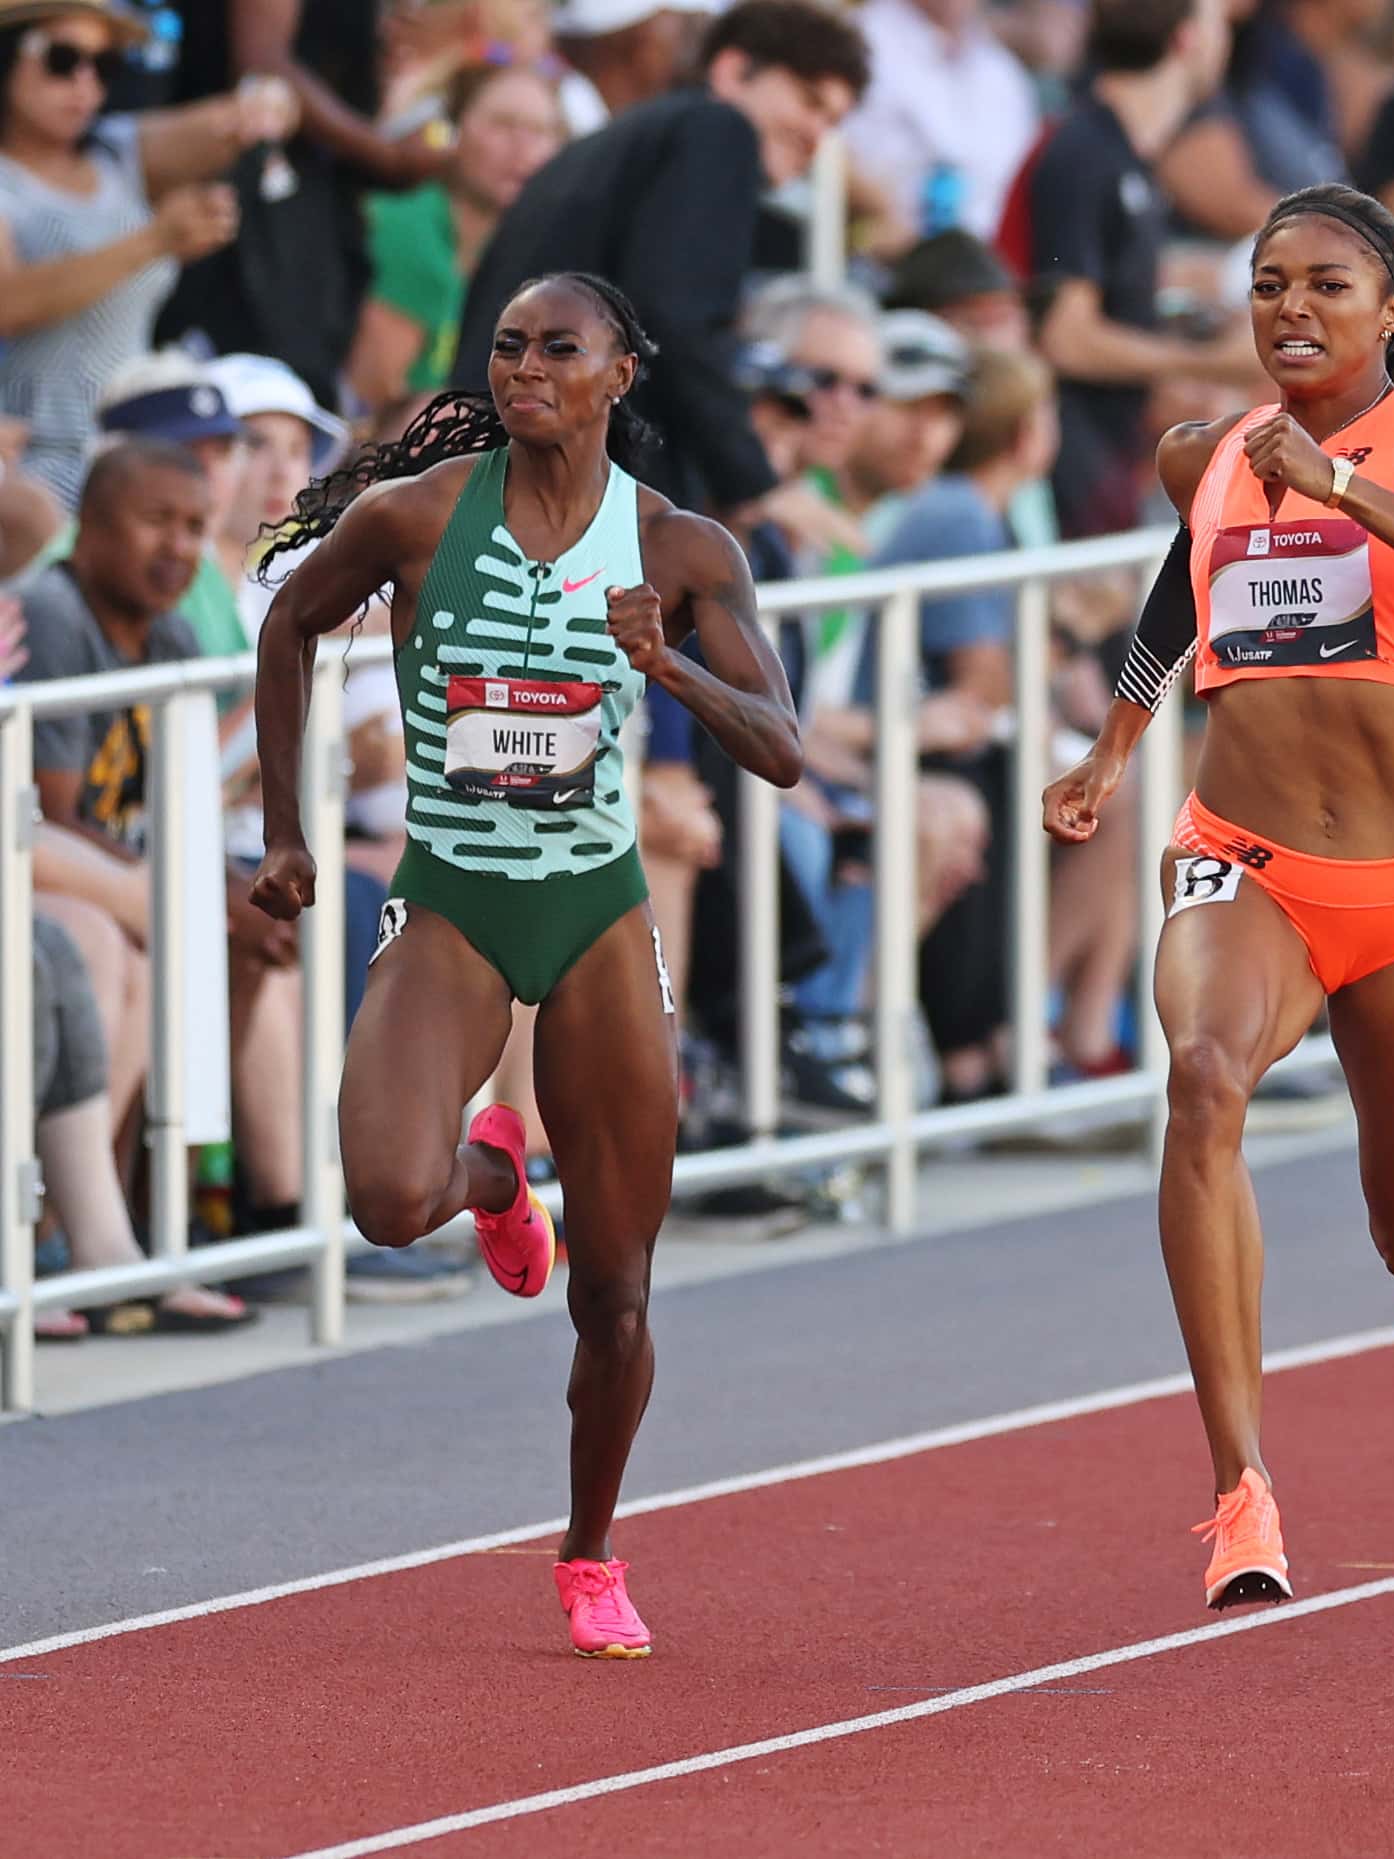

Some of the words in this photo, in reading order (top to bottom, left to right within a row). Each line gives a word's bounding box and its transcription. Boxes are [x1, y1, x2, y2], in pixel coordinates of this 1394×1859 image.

[1272, 531, 1323, 547] TOYOTA
[1247, 577, 1324, 608] THOMAS
[1241, 650, 1273, 661] USATF
[512, 690, 568, 705] TOYOTA
[492, 728, 557, 757] WHITE
